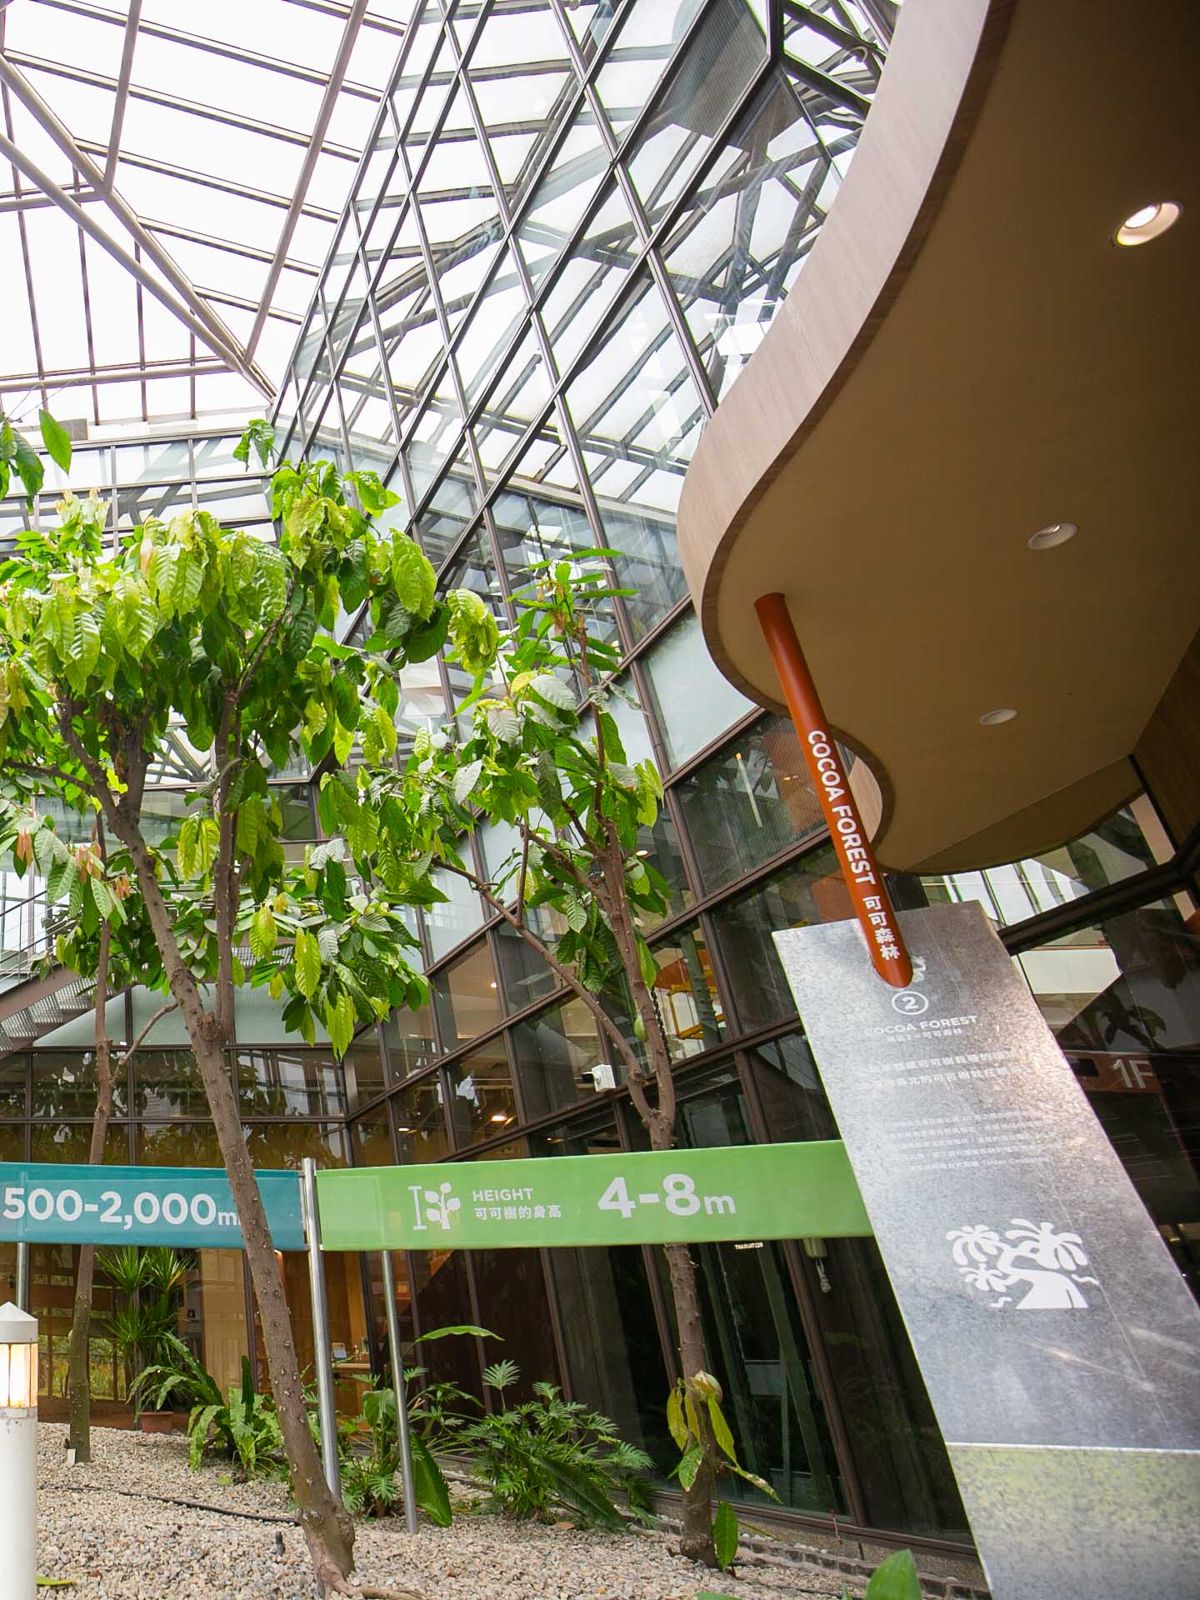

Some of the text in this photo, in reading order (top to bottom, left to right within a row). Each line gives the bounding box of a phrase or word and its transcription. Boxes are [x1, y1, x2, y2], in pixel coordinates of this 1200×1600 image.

[808, 730, 877, 885] COCOA FOREST
[862, 895, 901, 961] 可可森林
[919, 1015, 978, 1030] FOREST
[1112, 1058, 1154, 1089] 1F
[472, 1187, 534, 1203] HEIGHT
